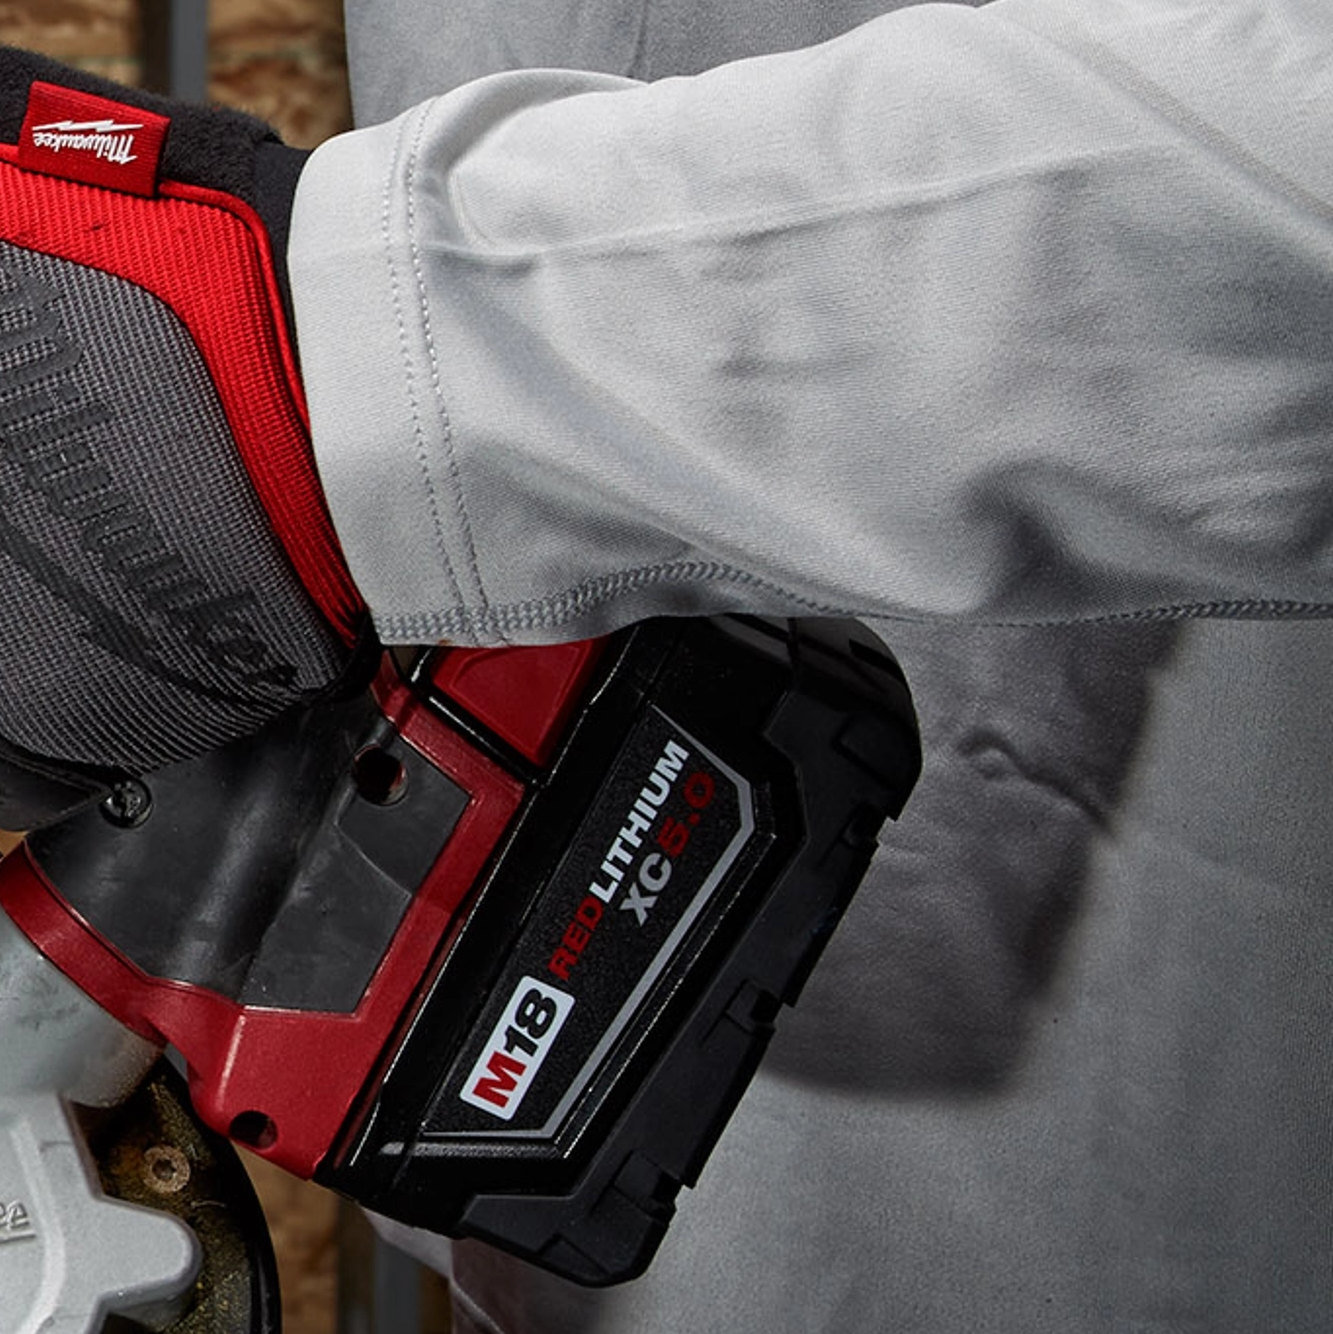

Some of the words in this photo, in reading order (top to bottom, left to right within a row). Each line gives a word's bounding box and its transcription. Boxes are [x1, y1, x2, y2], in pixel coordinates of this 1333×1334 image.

[32, 131, 137, 166] Milwaukee
[546, 739, 690, 980] REDLITHIUM
[473, 988, 560, 1109] M18
